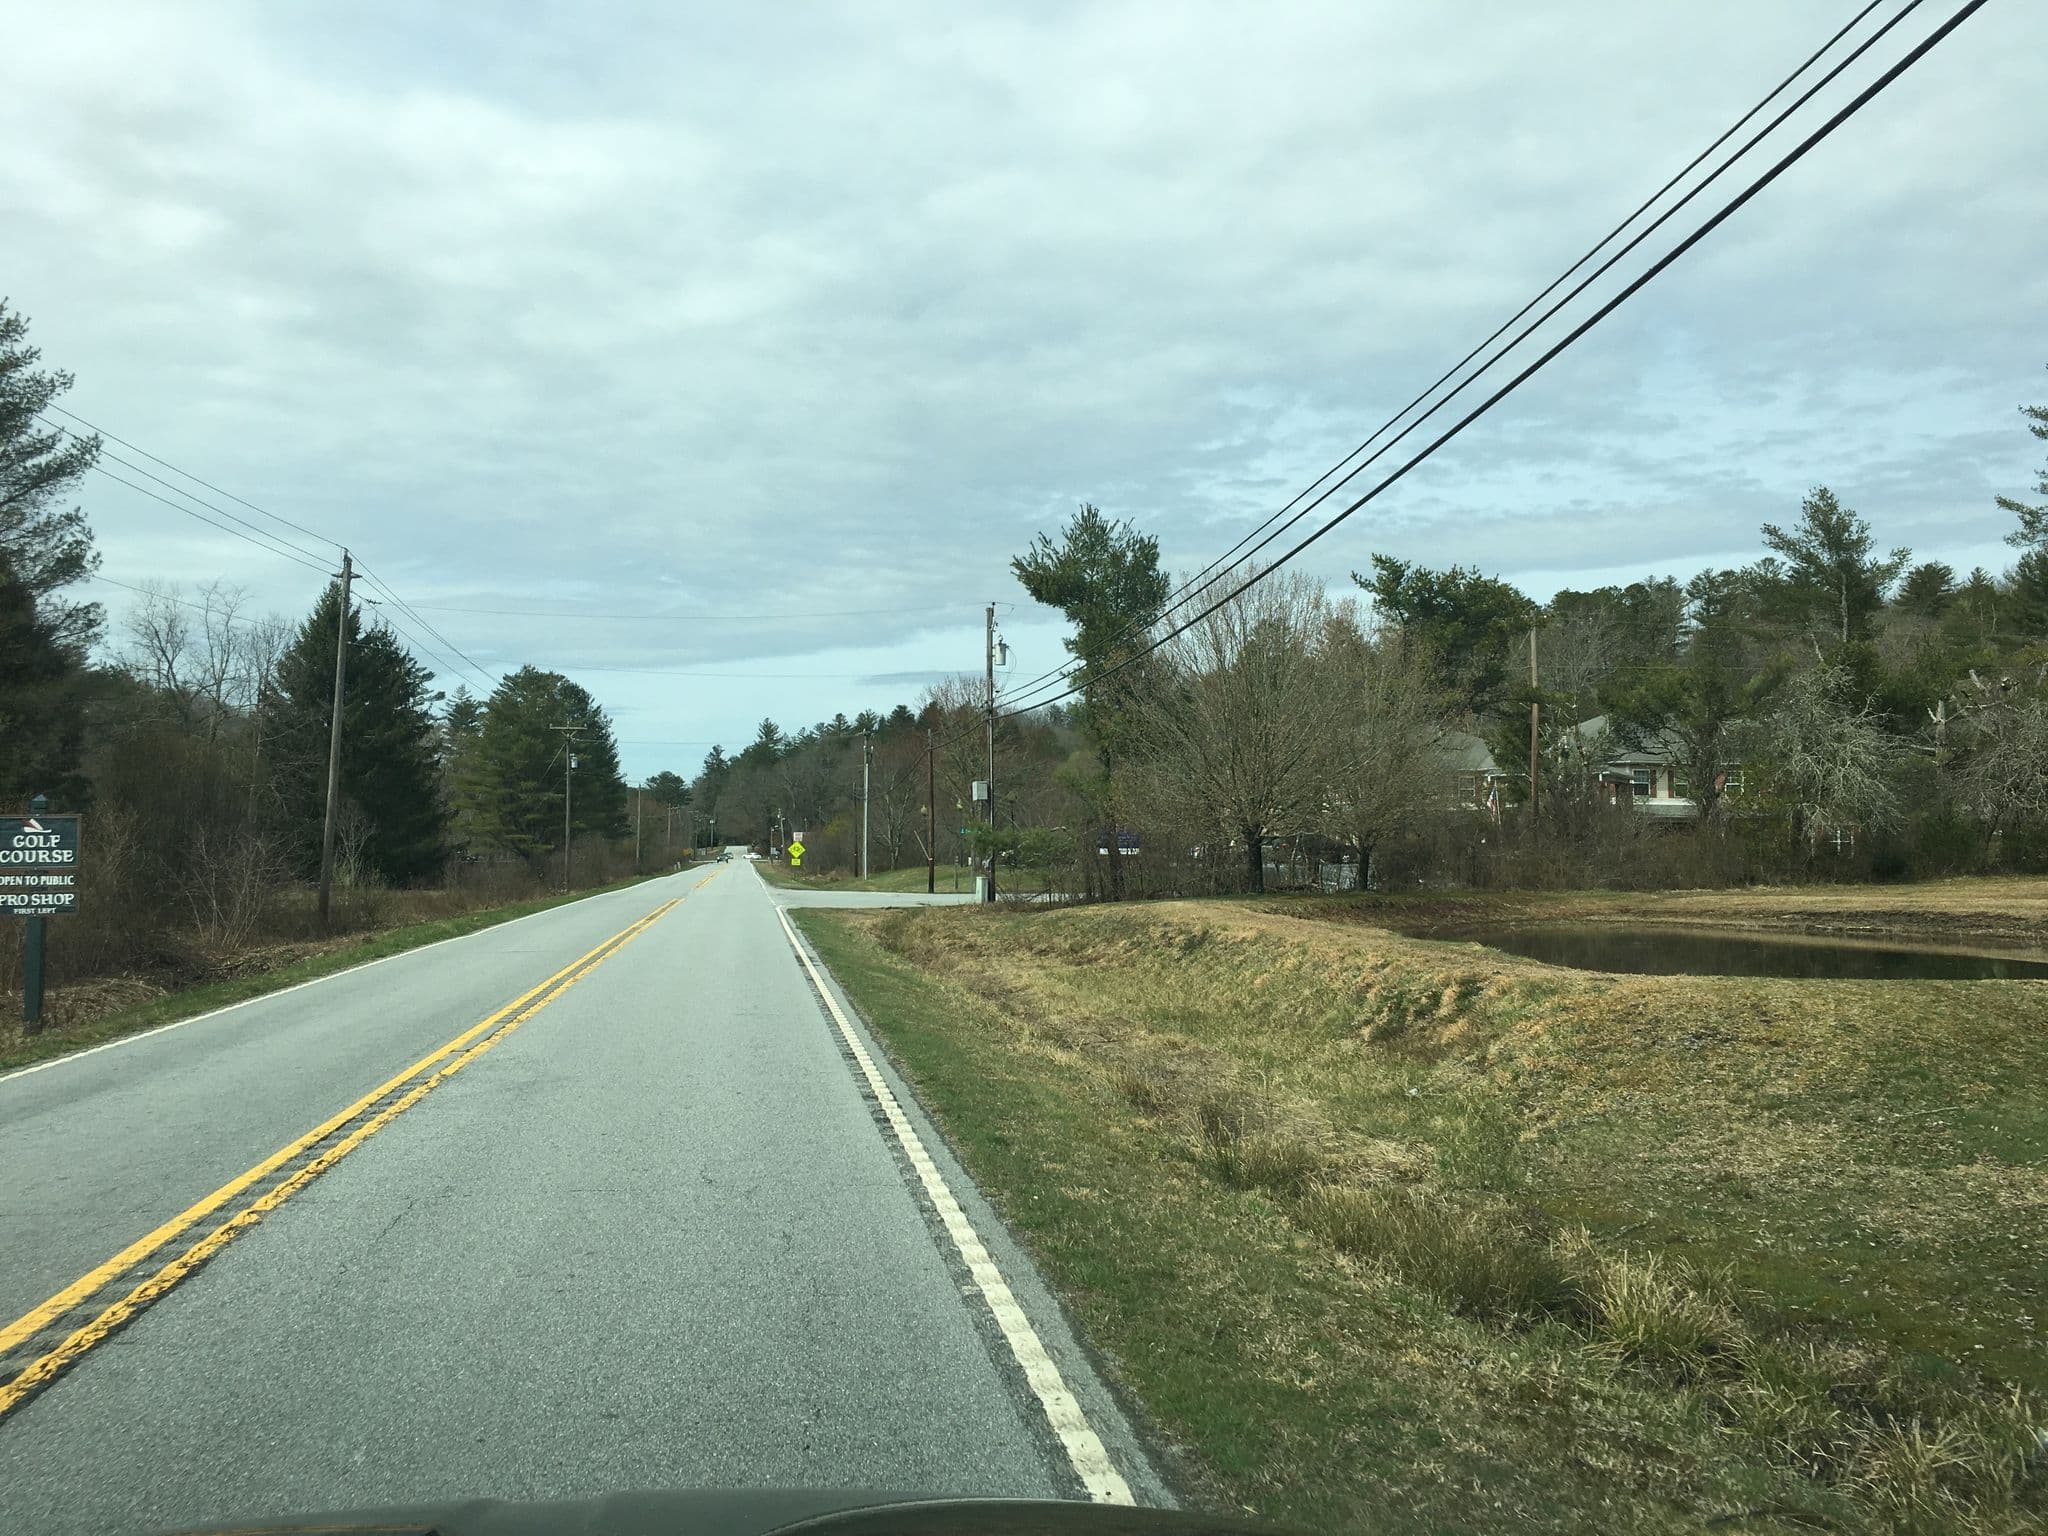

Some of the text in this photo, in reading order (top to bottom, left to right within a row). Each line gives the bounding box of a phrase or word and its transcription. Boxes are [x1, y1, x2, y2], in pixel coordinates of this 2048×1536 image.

[13, 835, 60, 848] GOLF
[0, 850, 74, 863] COURSE
[24, 876, 38, 886] TO
[40, 876, 75, 886] PUBLIC
[0, 893, 75, 906] PRO SHOP
